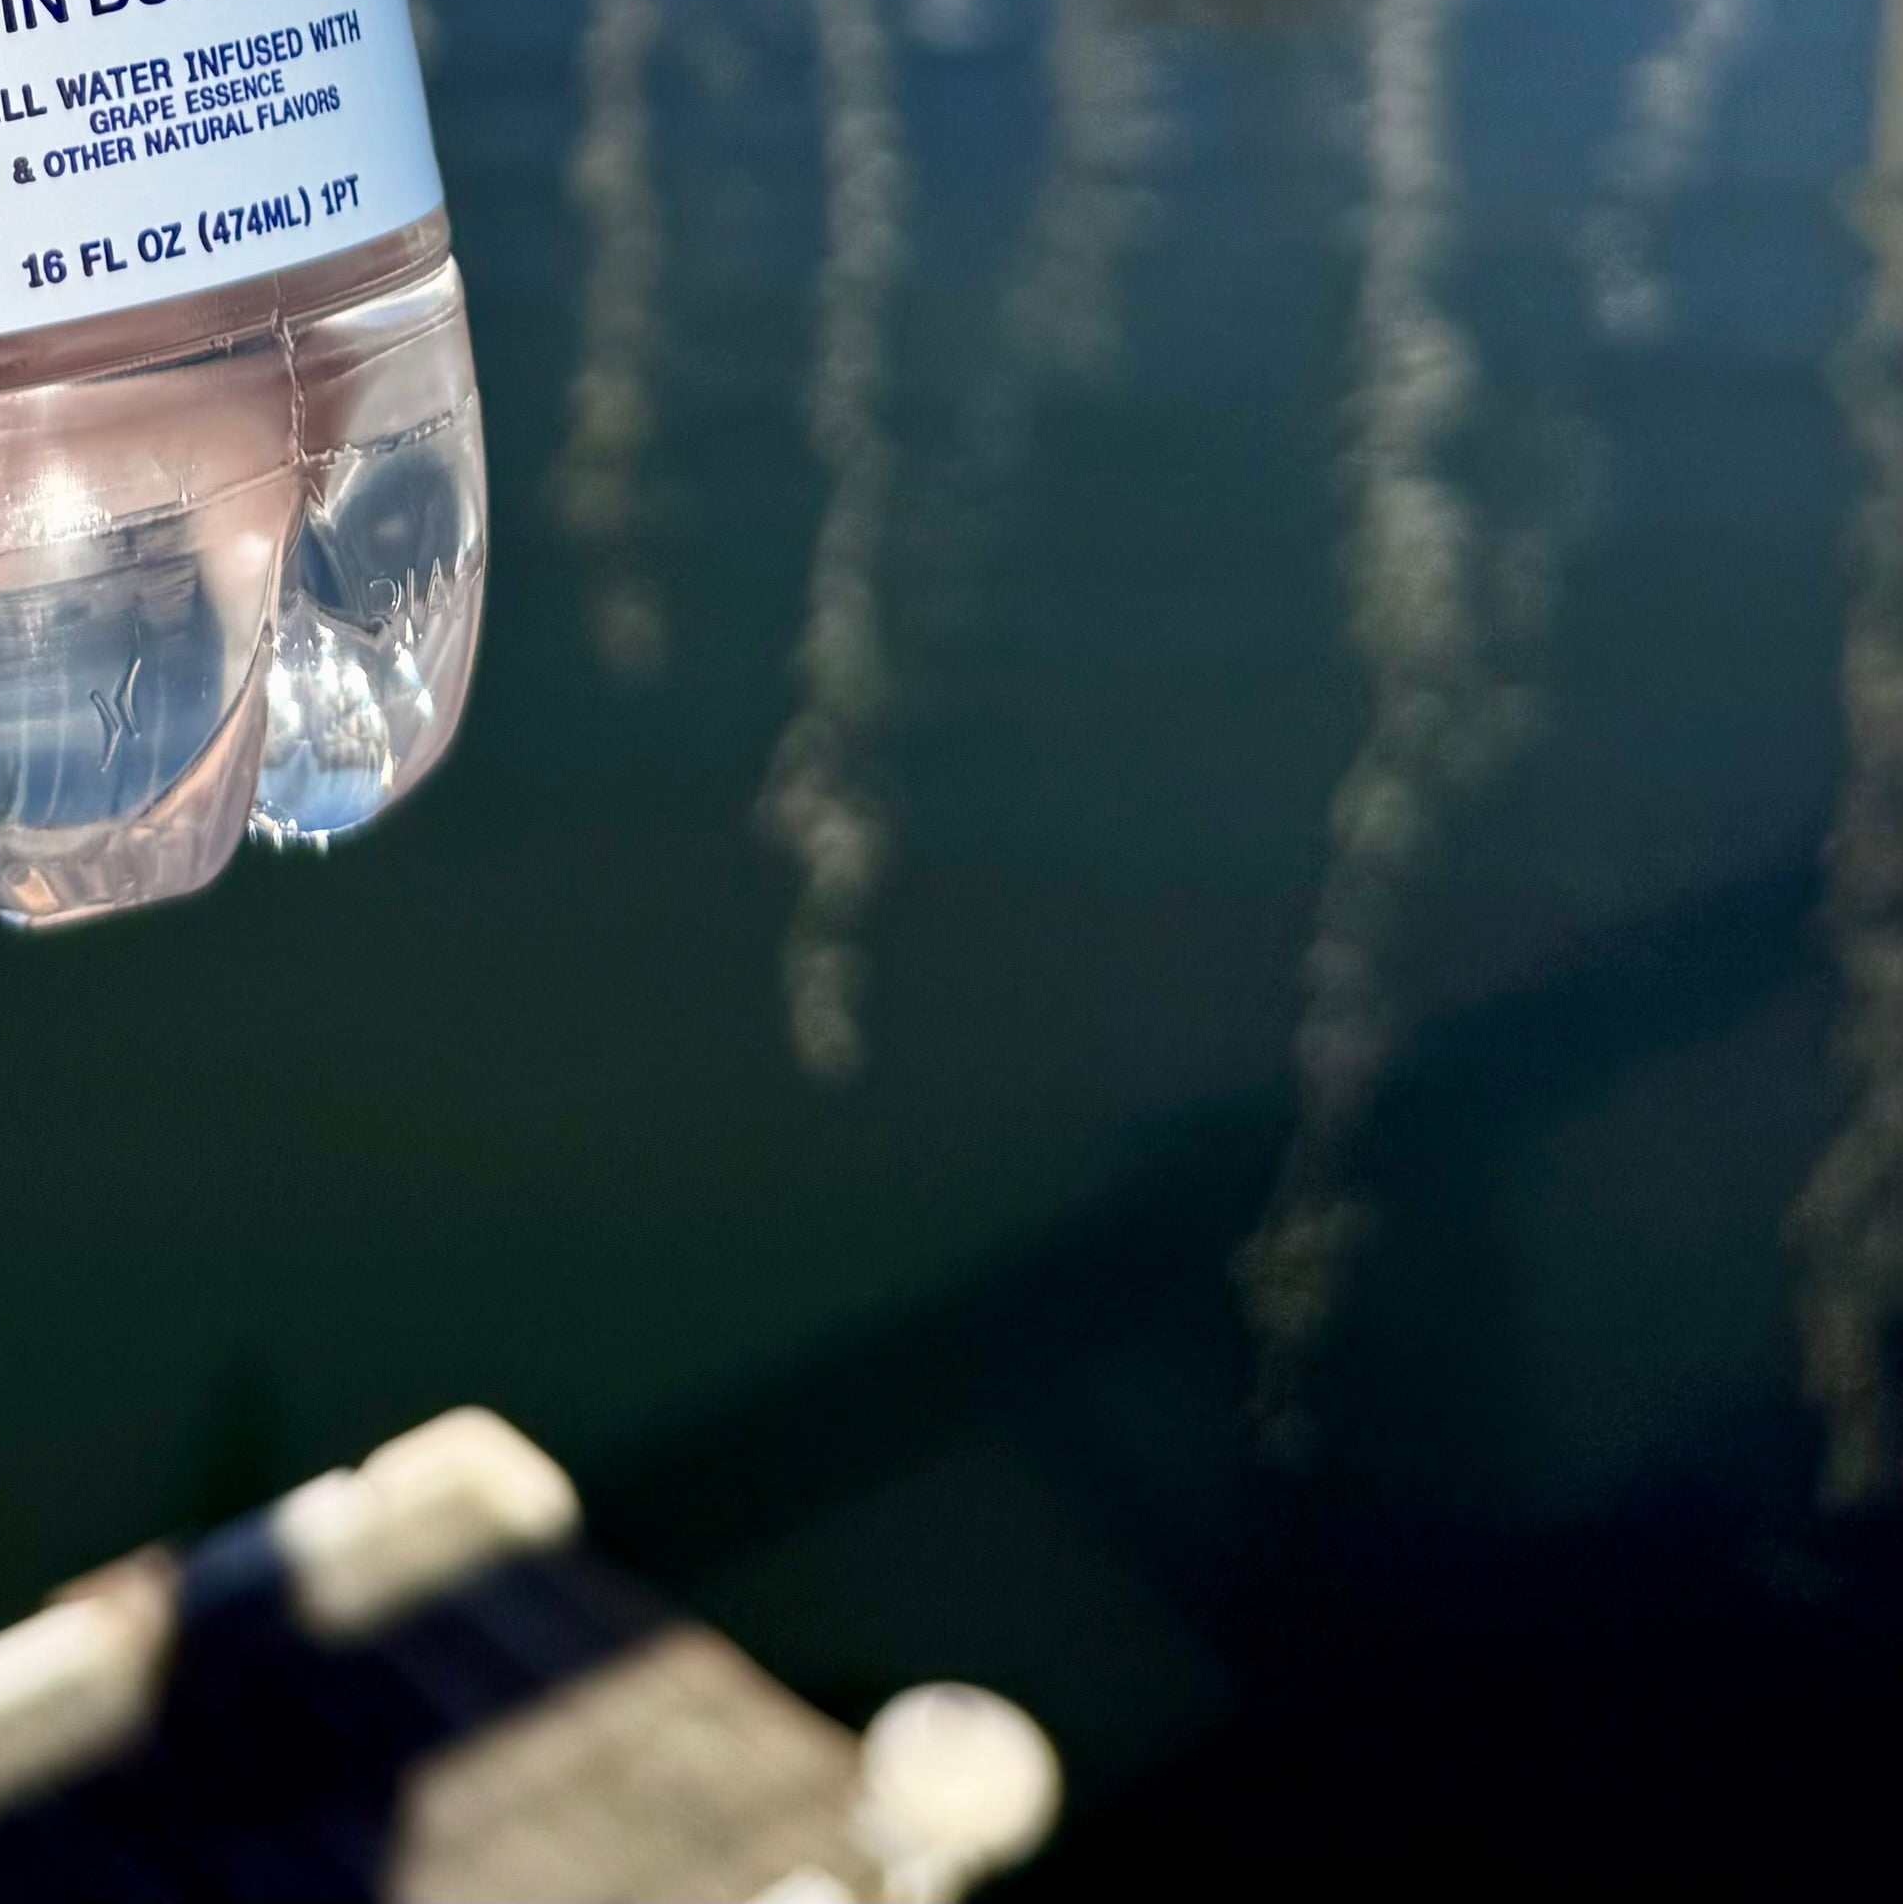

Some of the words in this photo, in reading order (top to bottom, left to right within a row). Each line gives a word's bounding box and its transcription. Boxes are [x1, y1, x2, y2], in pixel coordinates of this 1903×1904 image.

[56, 57, 173, 109] WATER
[184, 27, 303, 84] INFUSED
[308, 9, 361, 53] WITH
[89, 99, 177, 135] GRAPE
[187, 69, 285, 114] ESSENCE
[12, 156, 36, 185] &
[43, 136, 136, 178] OTHER
[145, 108, 253, 157] NATURAL
[258, 84, 341, 131] FLAVORS
[22, 249, 67, 288] 16
[80, 237, 128, 278] FL
[137, 223, 186, 263] OZ
[198, 186, 312, 253] (474ML)
[321, 174, 360, 216] 1PT
